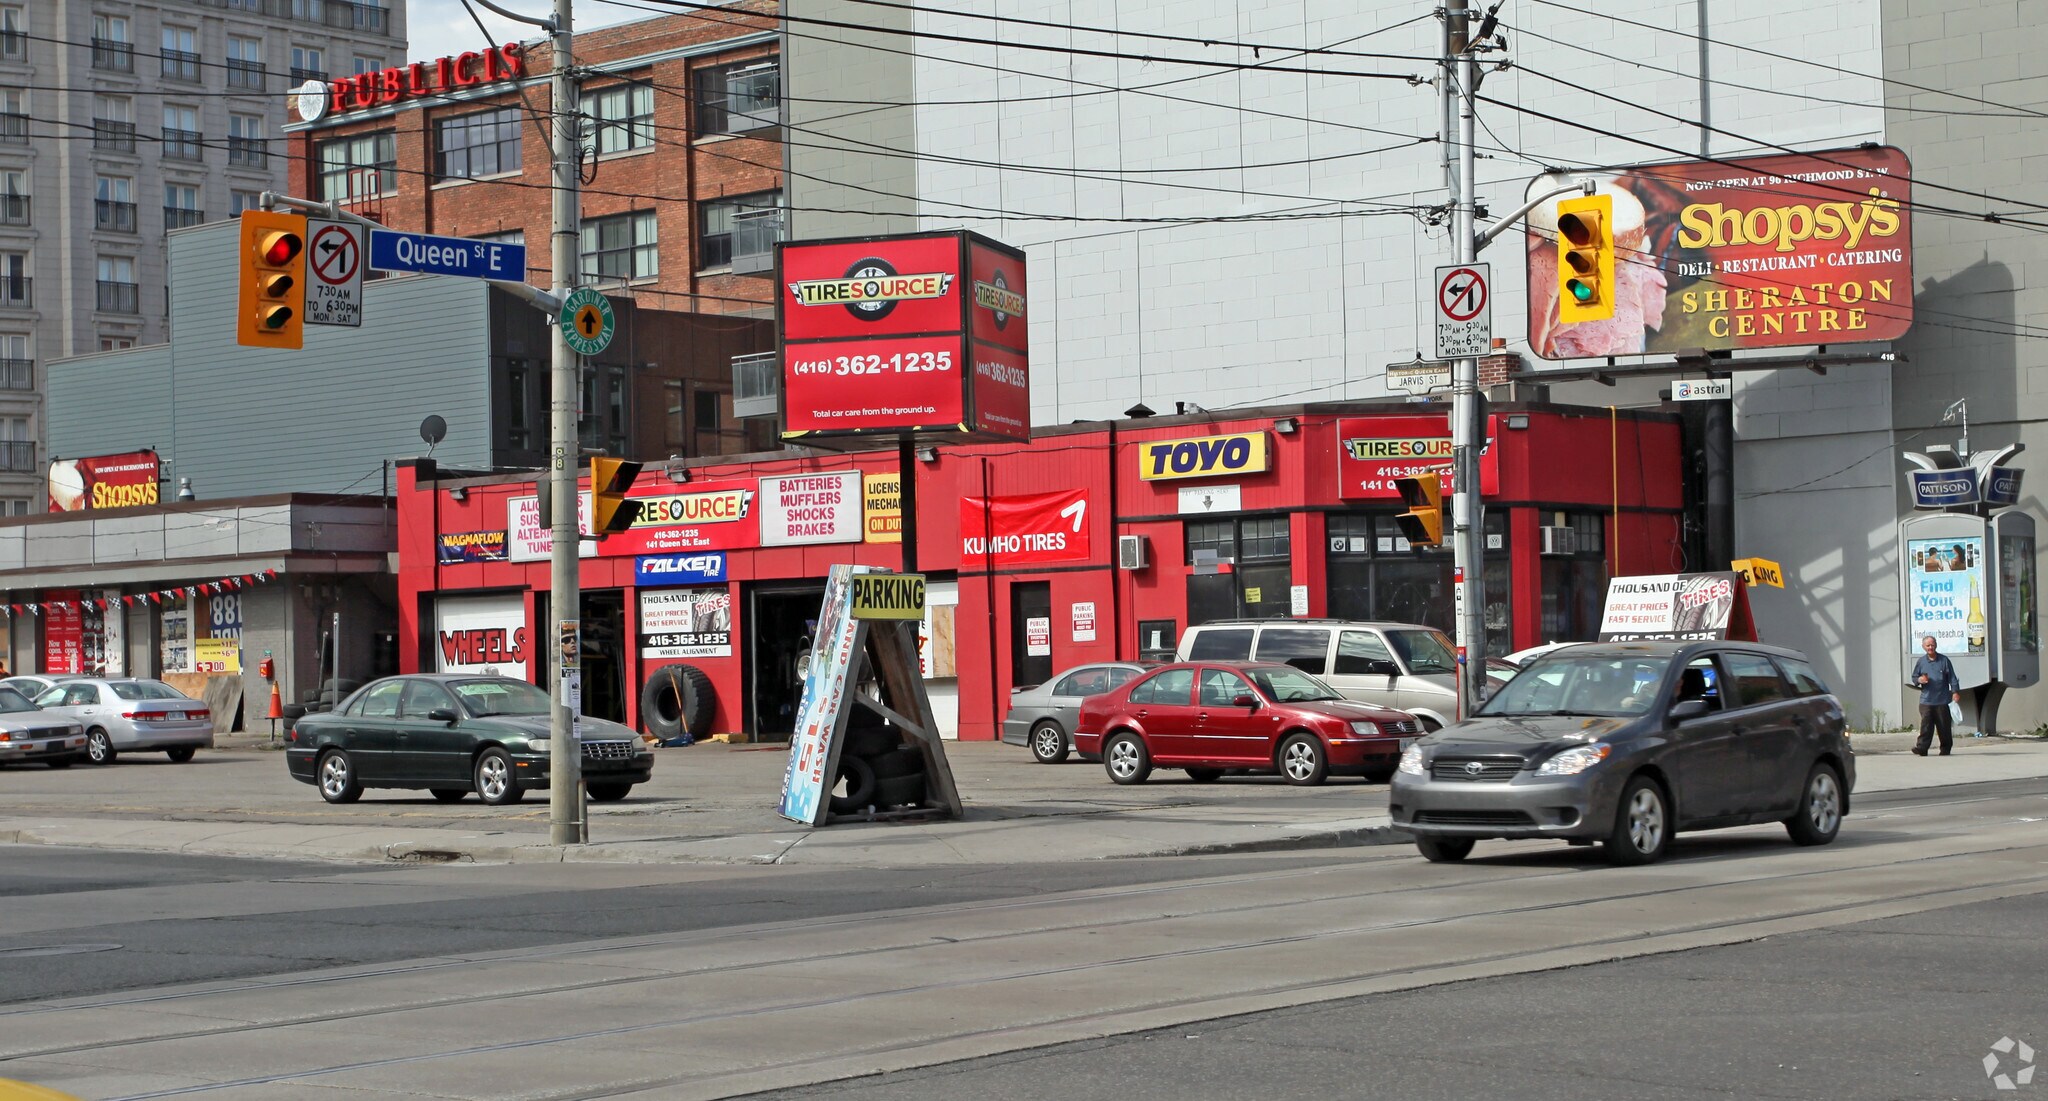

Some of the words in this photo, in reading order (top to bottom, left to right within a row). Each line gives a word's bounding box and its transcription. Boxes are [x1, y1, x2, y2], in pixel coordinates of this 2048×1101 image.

[331, 42, 522, 111] PUBLICIS
[1686, 181, 1714, 191] NOW
[1717, 177, 1750, 188] OPEN
[1752, 176, 1767, 186] AT
[1784, 170, 1854, 184] RICHMOND
[1678, 187, 1900, 251] Shopsy's
[396, 236, 468, 267] Queen
[474, 244, 486, 259] St
[490, 246, 502, 271] E
[1678, 262, 1711, 277] DELI
[1722, 254, 1818, 274] RESTAURANT
[1827, 249, 1902, 267] CATERING
[804, 277, 936, 301] TIRESOURCE
[1682, 279, 1893, 313] SHERATON
[308, 301, 318, 311] TO
[565, 290, 611, 316] GARDINER
[979, 285, 1020, 314] TIRESOURCE
[313, 313, 329, 322] MON
[337, 314, 351, 323] SAT
[1708, 308, 1867, 338] CENTRE
[562, 321, 612, 353] EXPRESSWAY
[1445, 347, 1461, 355] MON
[1470, 346, 1482, 354] FRI
[1881, 353, 1895, 361] 416
[794, 359, 832, 376] (416)
[835, 351, 952, 376] 362-1235
[990, 361, 1026, 389] 362-1235
[1399, 376, 1424, 387] JARVIS
[1693, 384, 1725, 395] astral
[813, 409, 830, 418] Total
[845, 409, 861, 417] care
[862, 407, 880, 416] from
[881, 407, 894, 415] the
[895, 406, 922, 417] ground
[924, 406, 936, 416] up.
[1150, 437, 1250, 475] TOYO
[1357, 441, 1452, 456] TIRESOUR
[779, 476, 842, 492] BATTERIES
[868, 482, 901, 494] LICENS
[1361, 481, 1382, 490] 141
[1920, 483, 1967, 494] PATTISON
[780, 491, 841, 507] MUFFLERS
[634, 496, 736, 523] RESOURCE
[787, 507, 835, 521] SHOCKS
[787, 522, 835, 537] BRAKES
[871, 518, 883, 531] ON
[654, 529, 699, 539] 416-362-1235
[646, 540, 657, 549] 141
[659, 539, 681, 548] Queen
[682, 539, 691, 547] St.
[694, 538, 710, 546] East
[963, 535, 1021, 555] KUMHO
[1022, 532, 1066, 552] TIRES
[641, 555, 722, 574] FALKEN
[703, 569, 719, 577] TIRE
[1612, 582, 1670, 594] THOUSAND
[1672, 581, 1687, 592] OF
[1920, 579, 1954, 593] Find
[643, 594, 687, 604] THOUSAND
[689, 594, 698, 603] OF
[853, 578, 924, 610] PARKING
[1680, 580, 1730, 611] TIRES
[1920, 594, 1955, 608] Your
[695, 594, 730, 617] TIRES
[1609, 603, 1639, 612] GREAT
[1640, 601, 1669, 611] PRICES
[1608, 615, 1630, 623] FAST
[1631, 614, 1666, 623] SERVICE
[1914, 607, 1963, 621] Beach
[661, 619, 688, 627] SERVICE
[440, 627, 526, 666] WHEELS
[648, 633, 728, 646] 416-362-1235
[840, 620, 855, 666] AND
[812, 725, 832, 783] WASH
